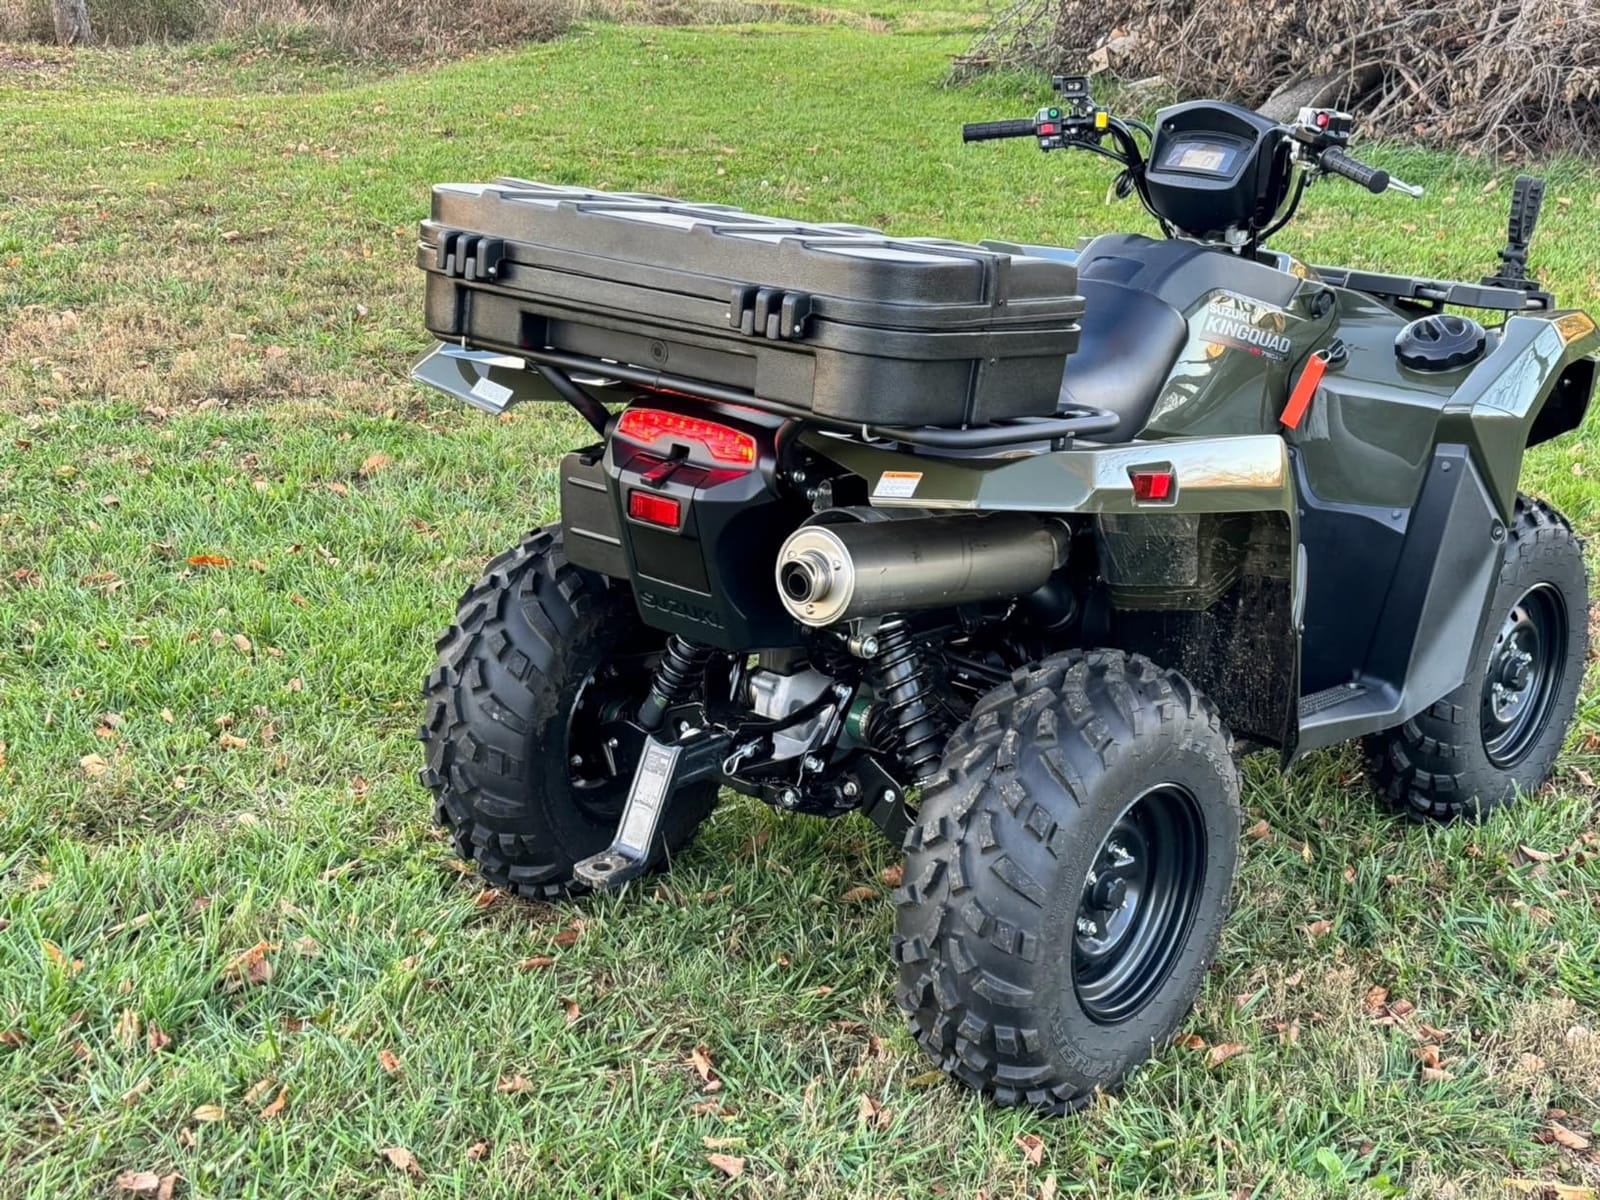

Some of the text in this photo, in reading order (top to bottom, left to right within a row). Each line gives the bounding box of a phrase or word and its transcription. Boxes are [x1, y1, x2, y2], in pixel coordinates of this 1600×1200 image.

[1208, 303, 1251, 321] SUZUKI
[1206, 315, 1292, 353] KINGQUAD
[640, 591, 725, 629] SUZUKI
